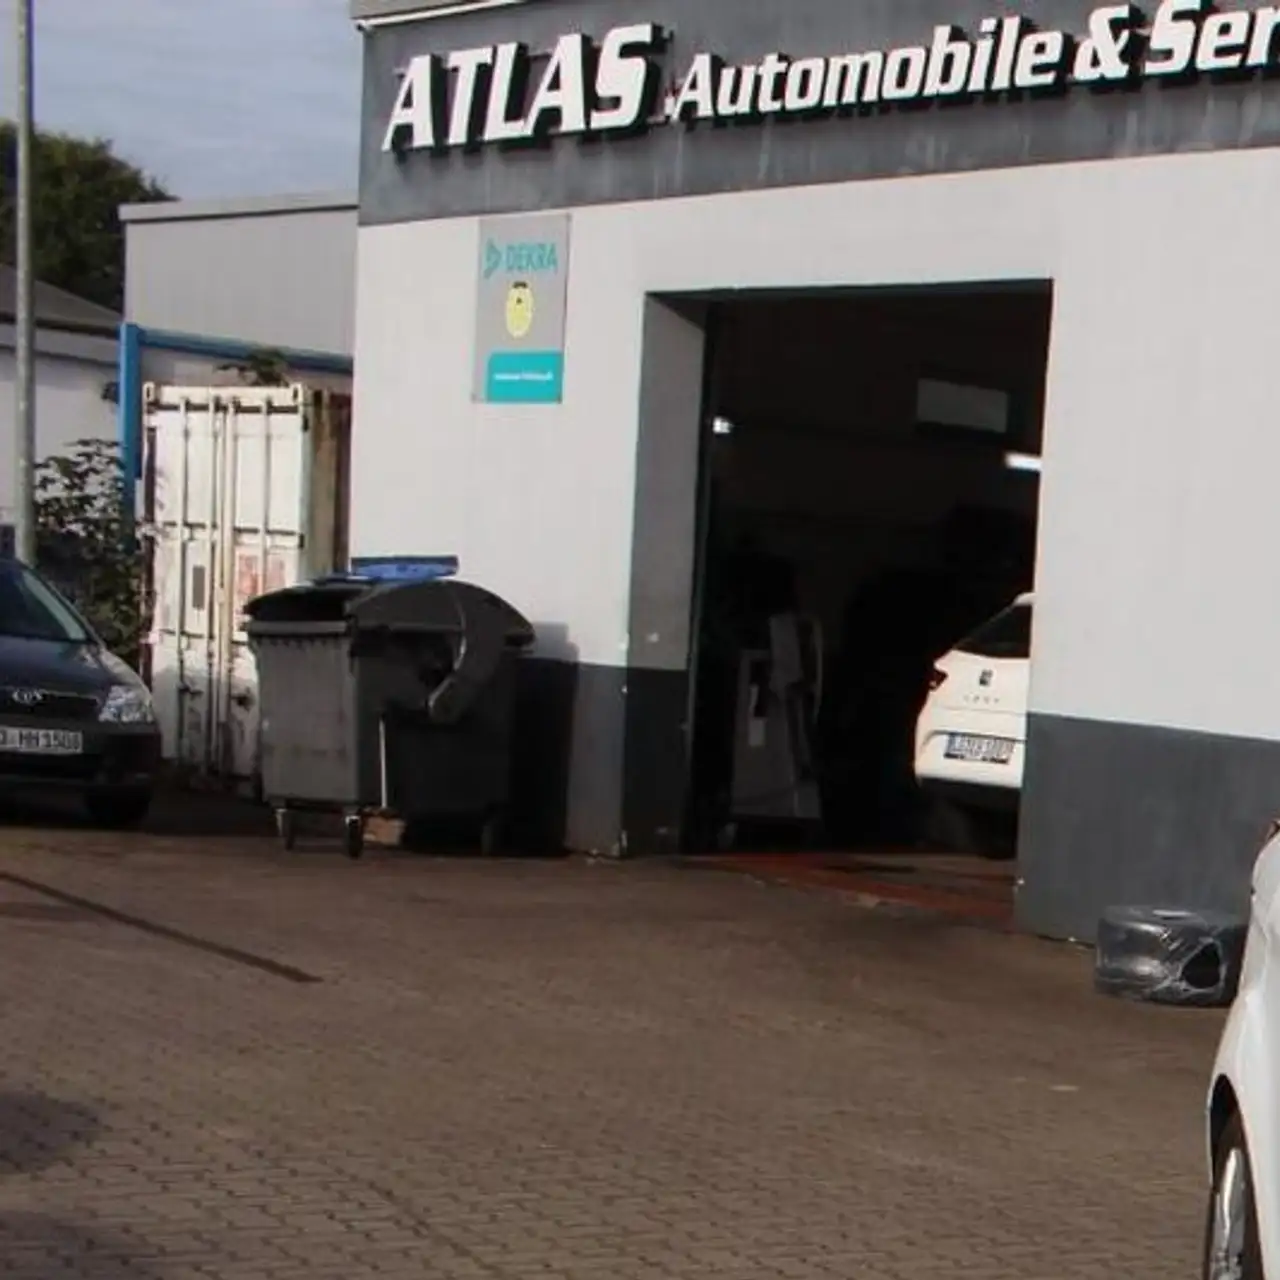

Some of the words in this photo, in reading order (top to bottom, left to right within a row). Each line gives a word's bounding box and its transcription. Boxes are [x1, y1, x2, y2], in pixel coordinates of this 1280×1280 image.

[380, 23, 653, 152] ATLAS
[669, 16, 1063, 121] Automobile
[1073, 4, 1129, 82] &
[506, 242, 559, 273] DEKRA
